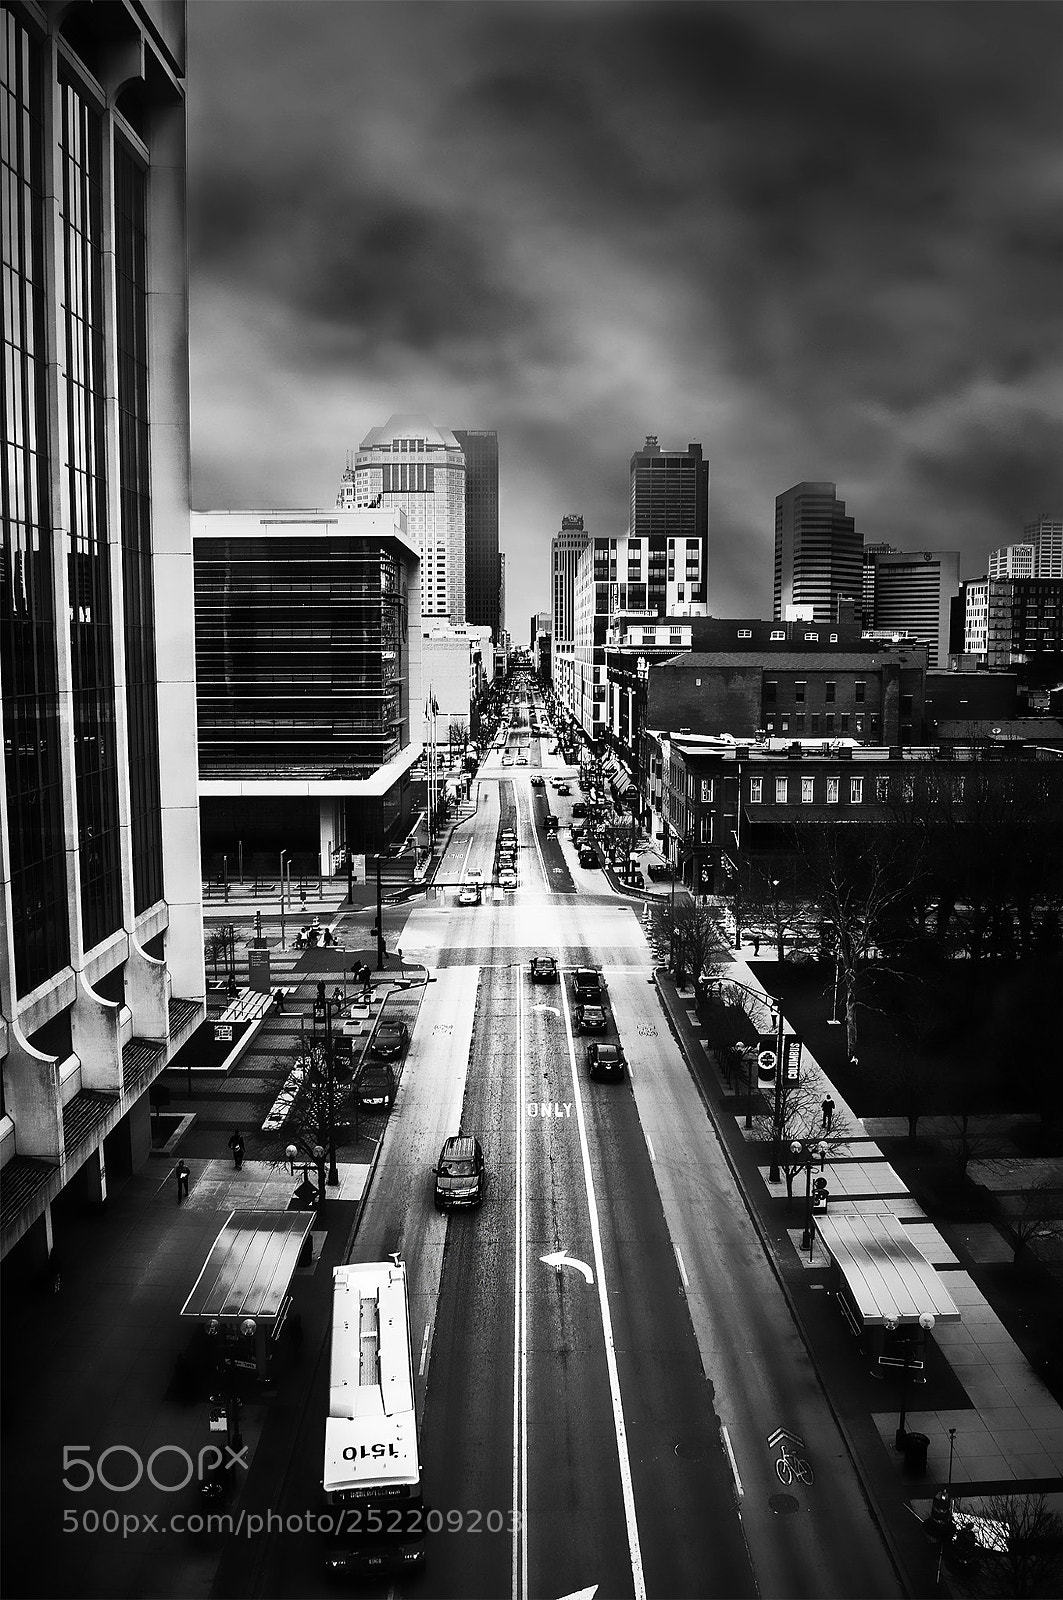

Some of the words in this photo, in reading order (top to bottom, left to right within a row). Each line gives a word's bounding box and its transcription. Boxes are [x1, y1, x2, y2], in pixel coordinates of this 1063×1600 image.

[788, 1042, 800, 1079] COLUMBUS
[527, 1102, 573, 1118] ONLY
[342, 1443, 399, 1462] 1510
